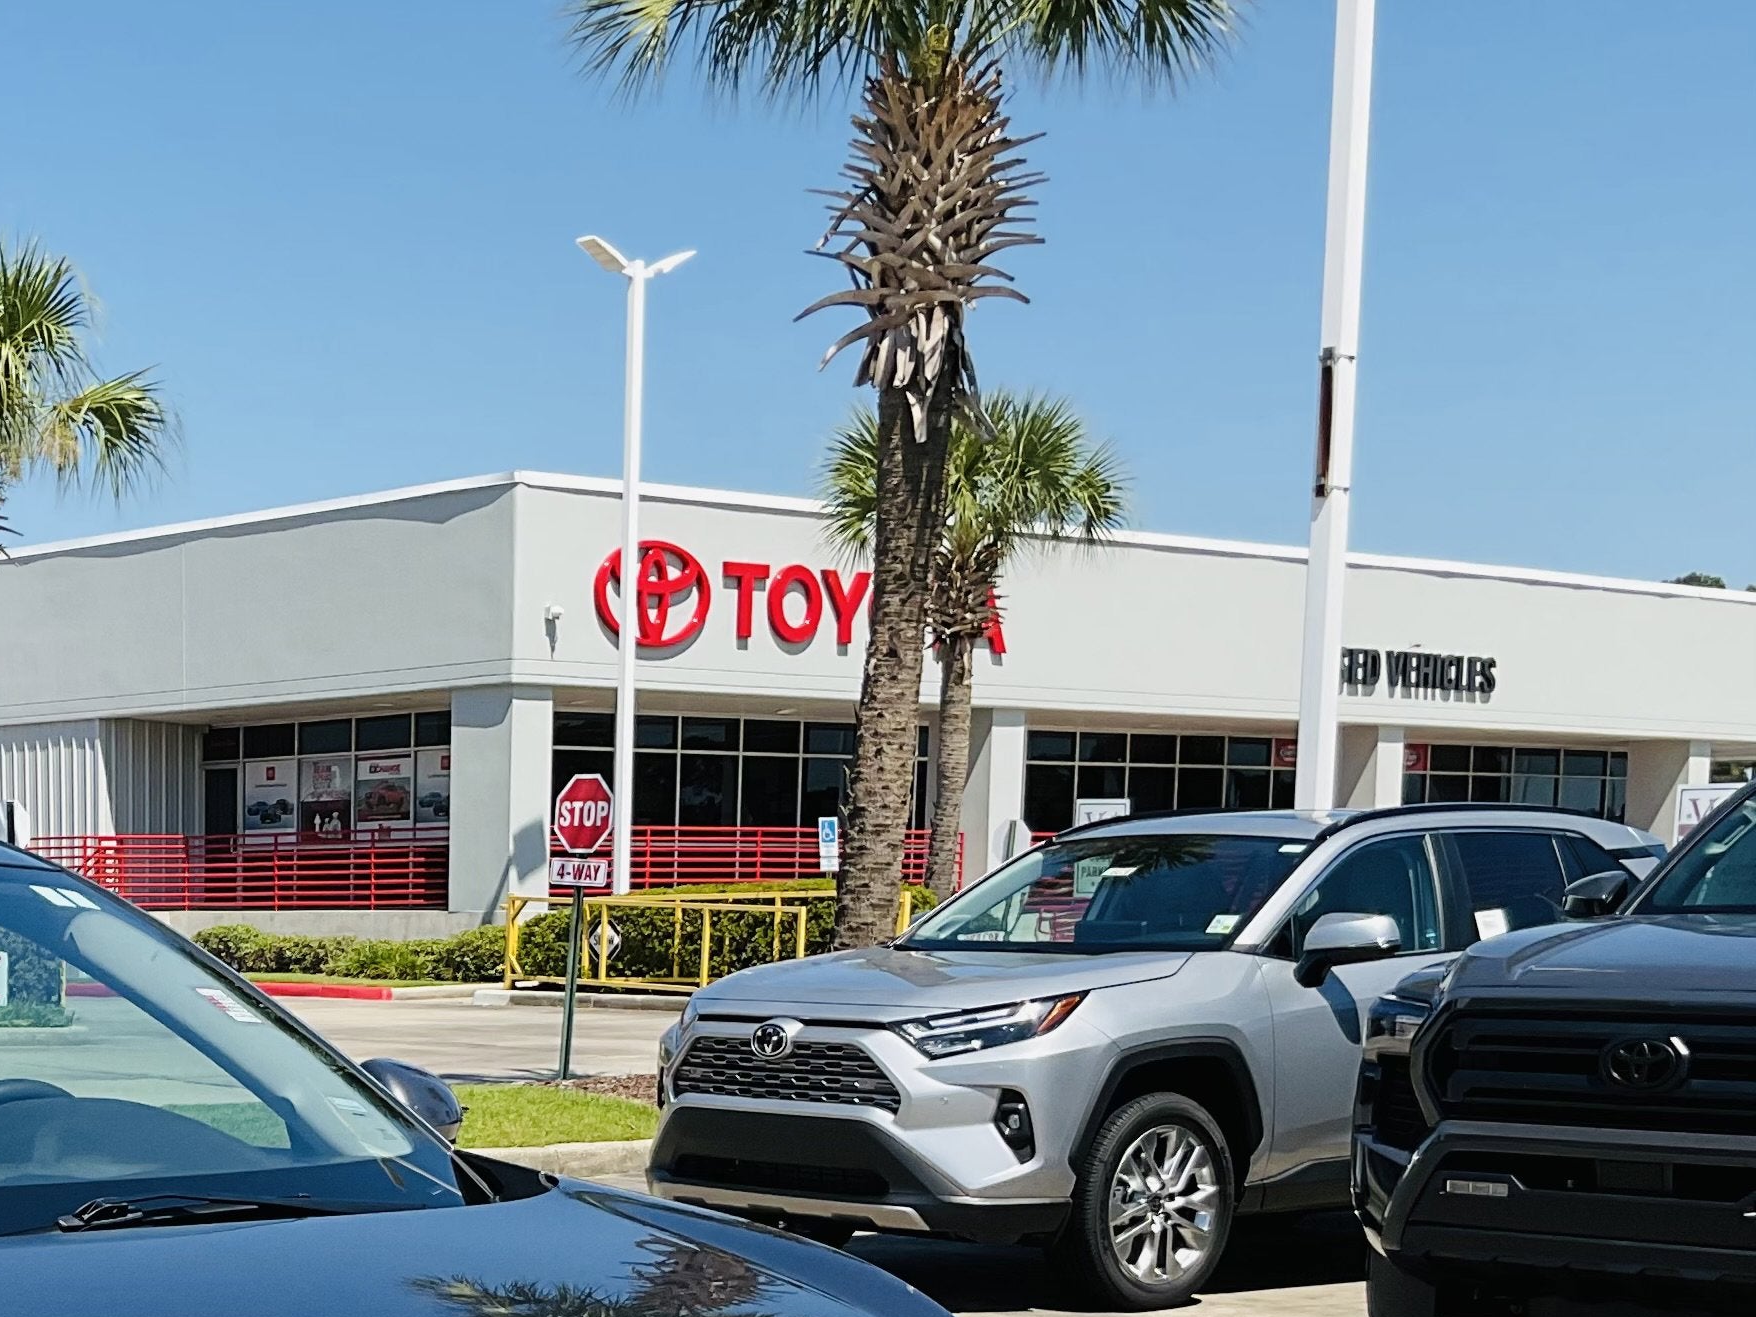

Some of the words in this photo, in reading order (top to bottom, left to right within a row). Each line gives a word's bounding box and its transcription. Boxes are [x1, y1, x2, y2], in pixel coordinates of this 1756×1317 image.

[722, 560, 1007, 654] TOY
[1385, 651, 1497, 693] VEHICLES
[559, 800, 608, 827] STOP
[557, 863, 601, 881] 4-WAY
